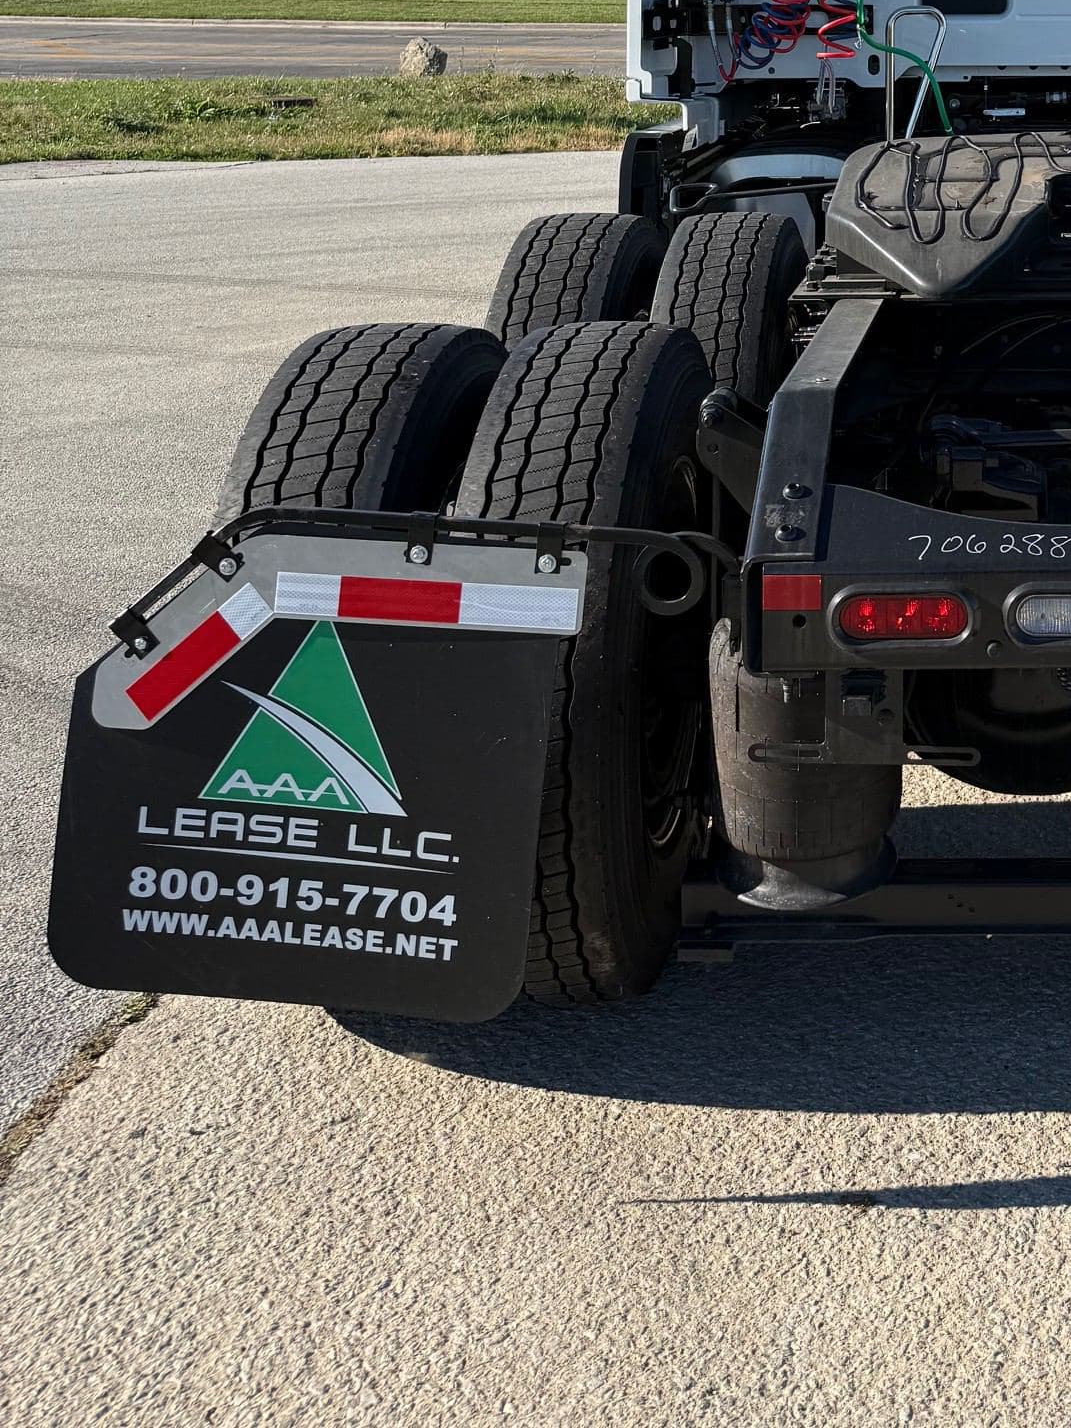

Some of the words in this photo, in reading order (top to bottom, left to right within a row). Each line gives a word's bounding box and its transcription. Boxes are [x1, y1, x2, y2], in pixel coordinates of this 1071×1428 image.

[217, 769, 350, 805] AAA
[138, 806, 319, 848] LEASE
[347, 824, 460, 863] LLC.
[128, 866, 457, 927] 800-915-7704
[122, 908, 459, 961] WWW.AAALEASE.NET
